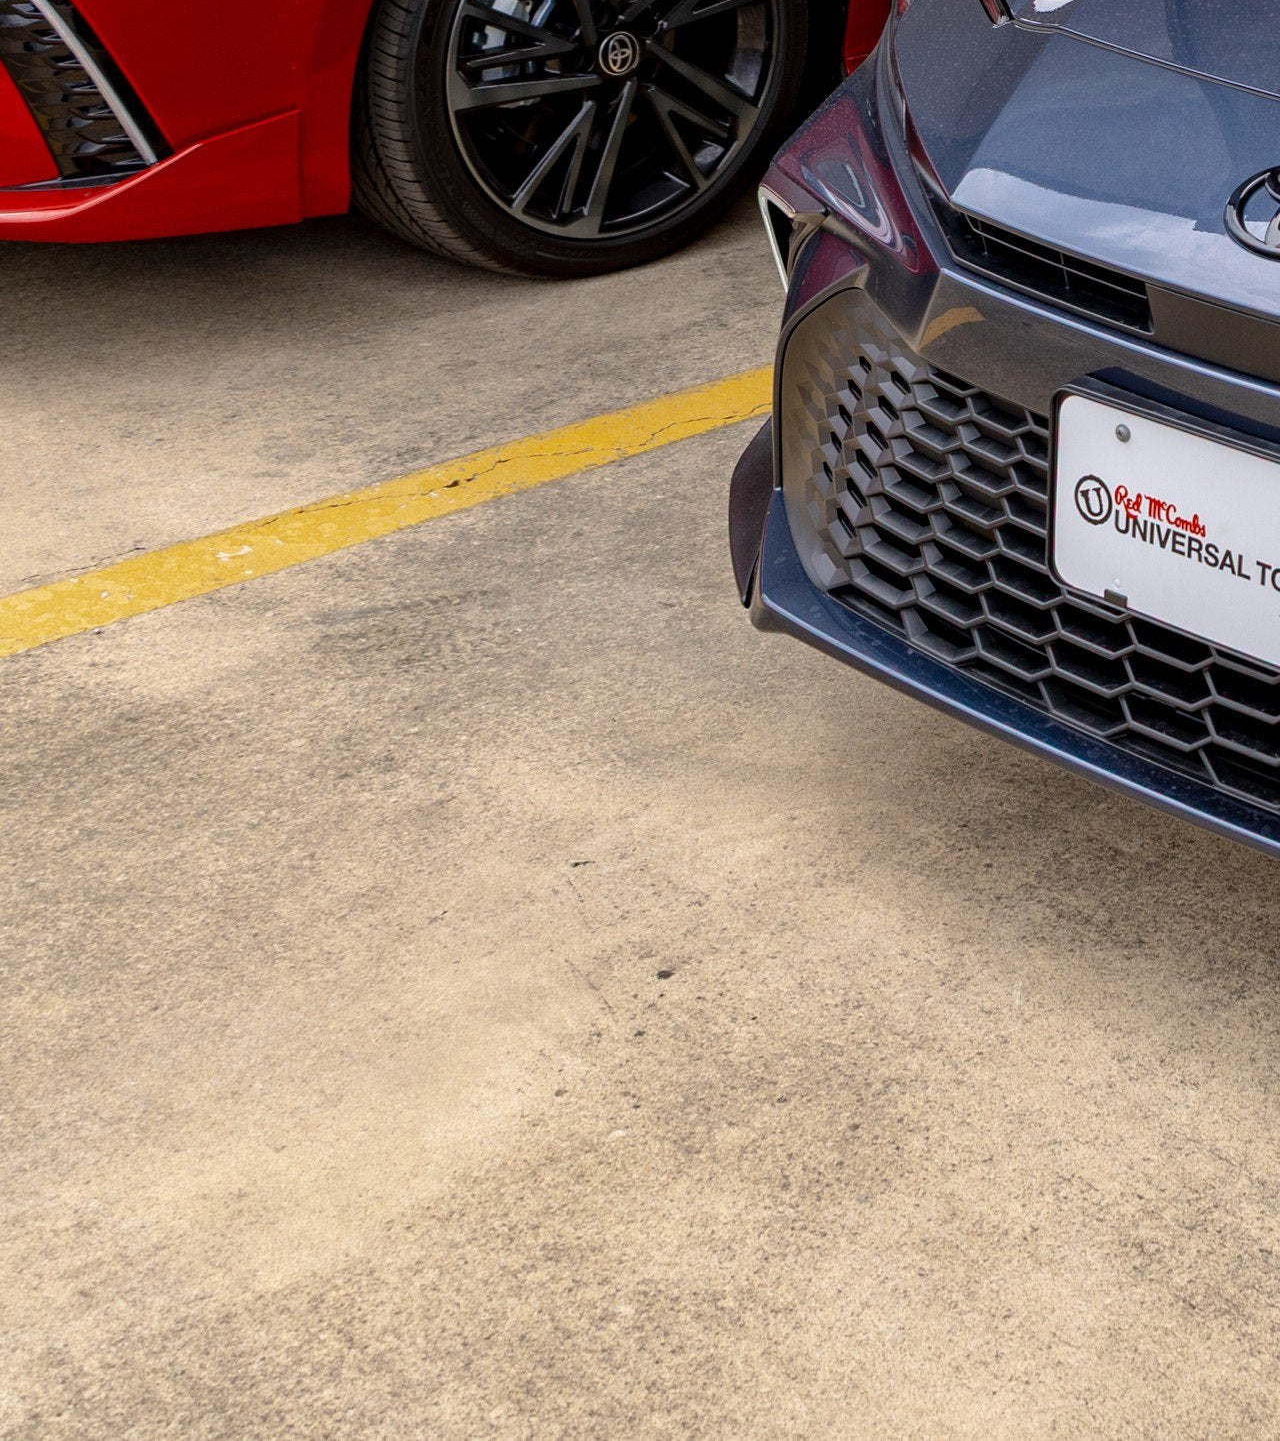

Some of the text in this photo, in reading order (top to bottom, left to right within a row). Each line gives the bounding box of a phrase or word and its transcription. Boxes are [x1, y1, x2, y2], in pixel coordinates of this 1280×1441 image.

[1114, 484, 1207, 538] Red McCombs
[1114, 509, 1252, 581] UNIVERSAL
